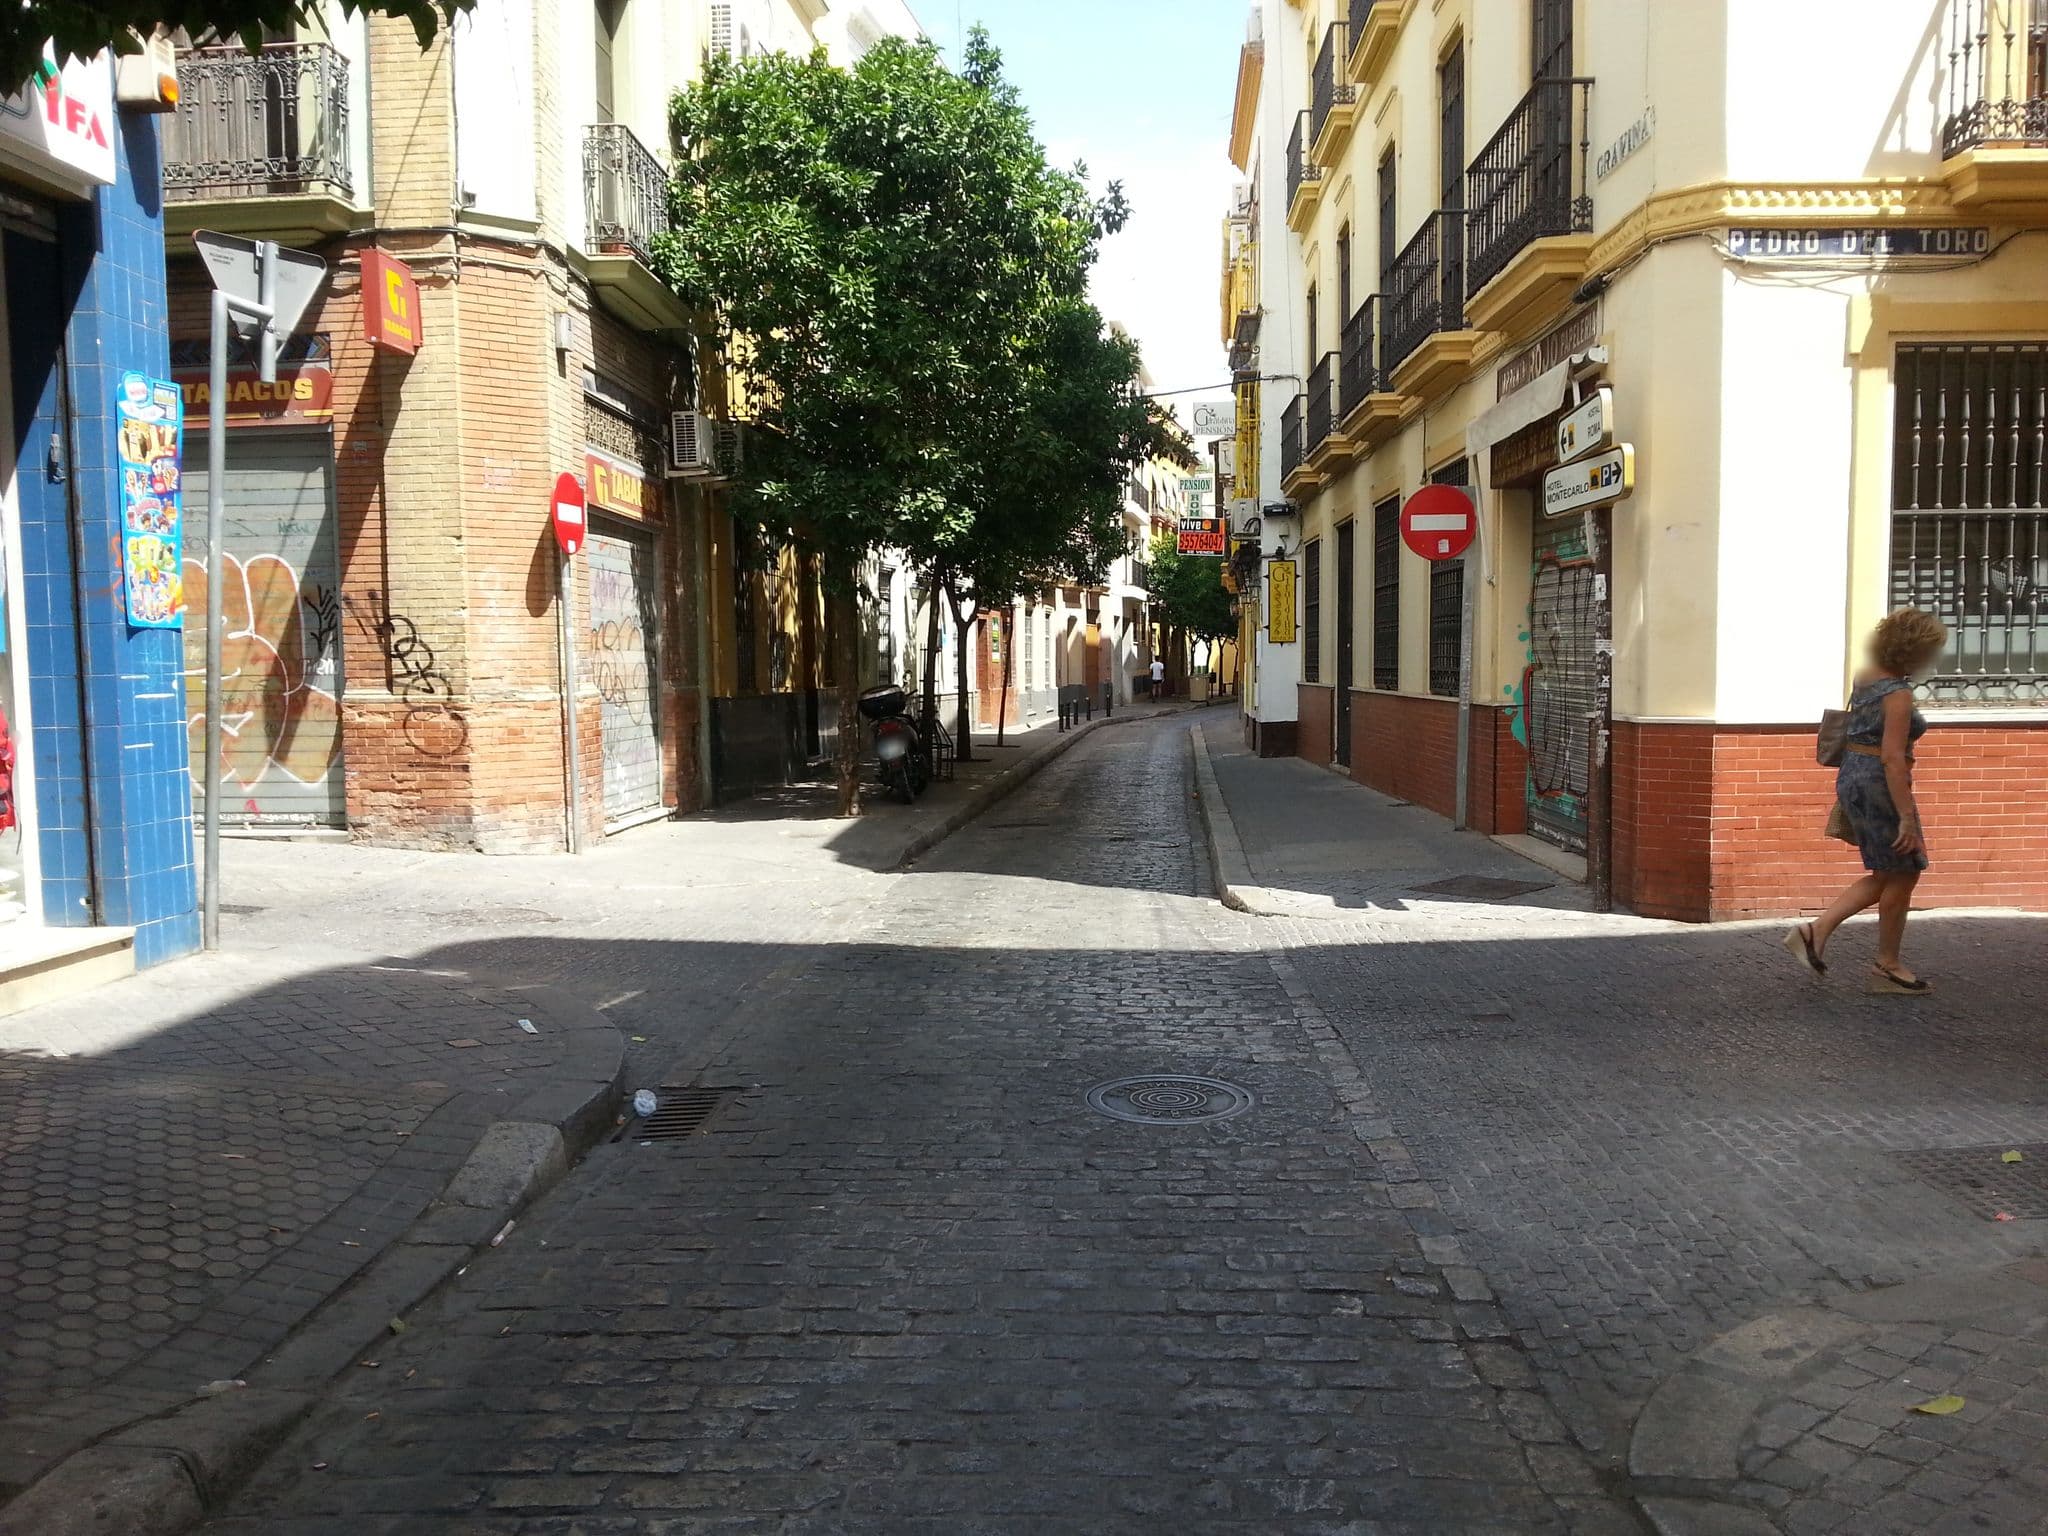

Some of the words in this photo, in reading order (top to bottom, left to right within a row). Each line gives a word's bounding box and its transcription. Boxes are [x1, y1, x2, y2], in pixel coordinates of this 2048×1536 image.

[1597, 116, 1650, 178] GRAVINA
[1730, 230, 1820, 253] PEDRO
[1842, 229, 1894, 253] DEL
[1919, 229, 1988, 253] TORO
[1529, 334, 1558, 382] ROJO
[1587, 421, 1601, 439] ROMA
[1179, 479, 1211, 490] PENSION
[1547, 480, 1564, 492] HOTEL
[1547, 482, 1589, 504] MONTECARLO
